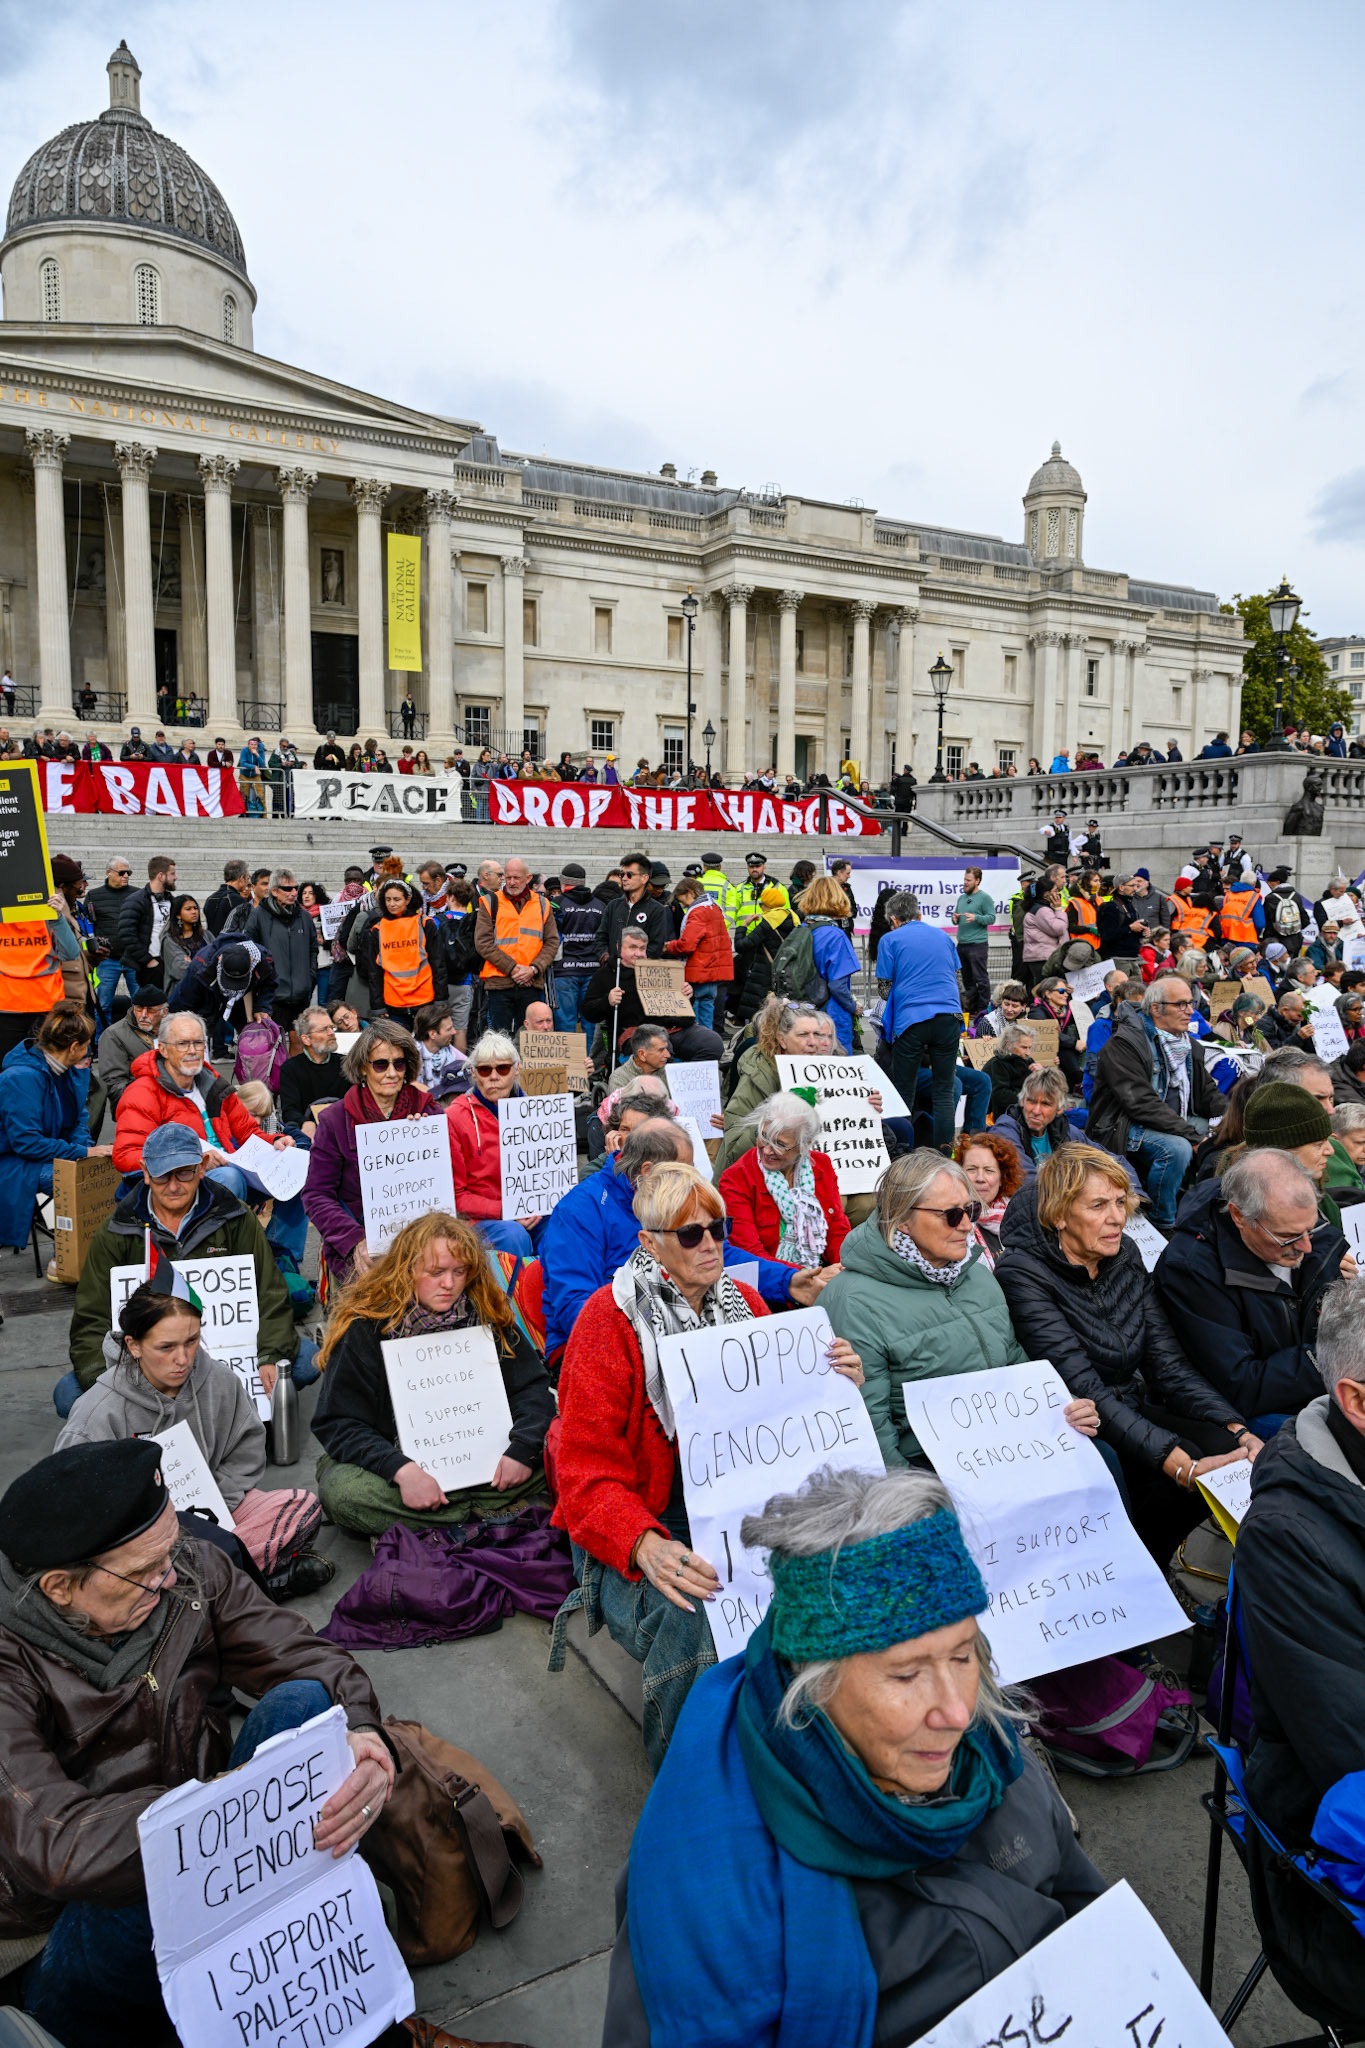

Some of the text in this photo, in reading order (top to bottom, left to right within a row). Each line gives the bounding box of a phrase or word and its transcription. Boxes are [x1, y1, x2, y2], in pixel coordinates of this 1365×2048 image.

[69, 397, 211, 433] NATIONAL
[229, 423, 341, 453] GALLERY
[396, 557, 405, 621] NATIONAL
[405, 559, 416, 623] GALLERY
[100, 763, 224, 818] BAN
[316, 777, 449, 813] PEACE
[491, 779, 613, 828] DROP
[621, 787, 696, 831] THE
[2, 839, 15, 847] act
[877, 880, 965, 895] Disarm Isra
[918, 901, 941, 918] ing
[382, 939, 417, 950] WELFAR
[638, 978, 672, 988] GENOCIDE
[639, 966, 671, 978] I OPPOSE
[645, 999, 687, 1009] PALESTINE
[648, 1007, 677, 1015] ACTION
[523, 1045, 571, 1059] GENOCIDE
[525, 1033, 568, 1046] I OPPOSE
[672, 1079, 713, 1092] GENOCIDE
[680, 1067, 711, 1081] OPPOSE
[790, 1063, 869, 1084] I OPPOSE
[506, 1097, 568, 1120] I OPPOSE
[364, 1124, 440, 1146] I OPPOSE
[502, 1118, 573, 1146] GENOCIDE
[507, 1142, 577, 1173] I SUPPORT
[812, 1138, 885, 1152] ALESTINE
[363, 1147, 441, 1172] GENOCIDE
[833, 1155, 881, 1170] TION
[81, 1175, 116, 1193] GENOCIDE
[370, 1177, 435, 1201] I SUPPORT
[370, 1197, 441, 1220] PALESTINE
[118, 1266, 253, 1303] I POSE
[397, 1340, 472, 1367] I OPPOSE
[680, 1323, 835, 1403] I OPPOS
[407, 1369, 475, 1391] GENOCIDE
[408, 1401, 483, 1429] I SUPPORT
[922, 1380, 1061, 1442] I OPPOSE
[414, 1426, 485, 1450] PALESTINE
[687, 1406, 859, 1489] GENOCIDE
[420, 1452, 472, 1472] ACTION
[956, 1432, 1076, 1479] GENOCIDE
[166, 1467, 198, 1495] PPORT
[1210, 1467, 1251, 1488] I OPPOSE
[719, 1530, 733, 1583] I
[984, 1541, 999, 1566] I
[986, 1561, 1116, 1618] PALESTINE
[1039, 1604, 1128, 1643] ACTION
[174, 1823, 190, 1877] I
[198, 1751, 329, 1859] OPPOSE
[203, 1810, 323, 1908] GENOCI
[208, 1889, 353, 2012] I SUPPORT
[233, 1933, 376, 2048] PALESTINE
